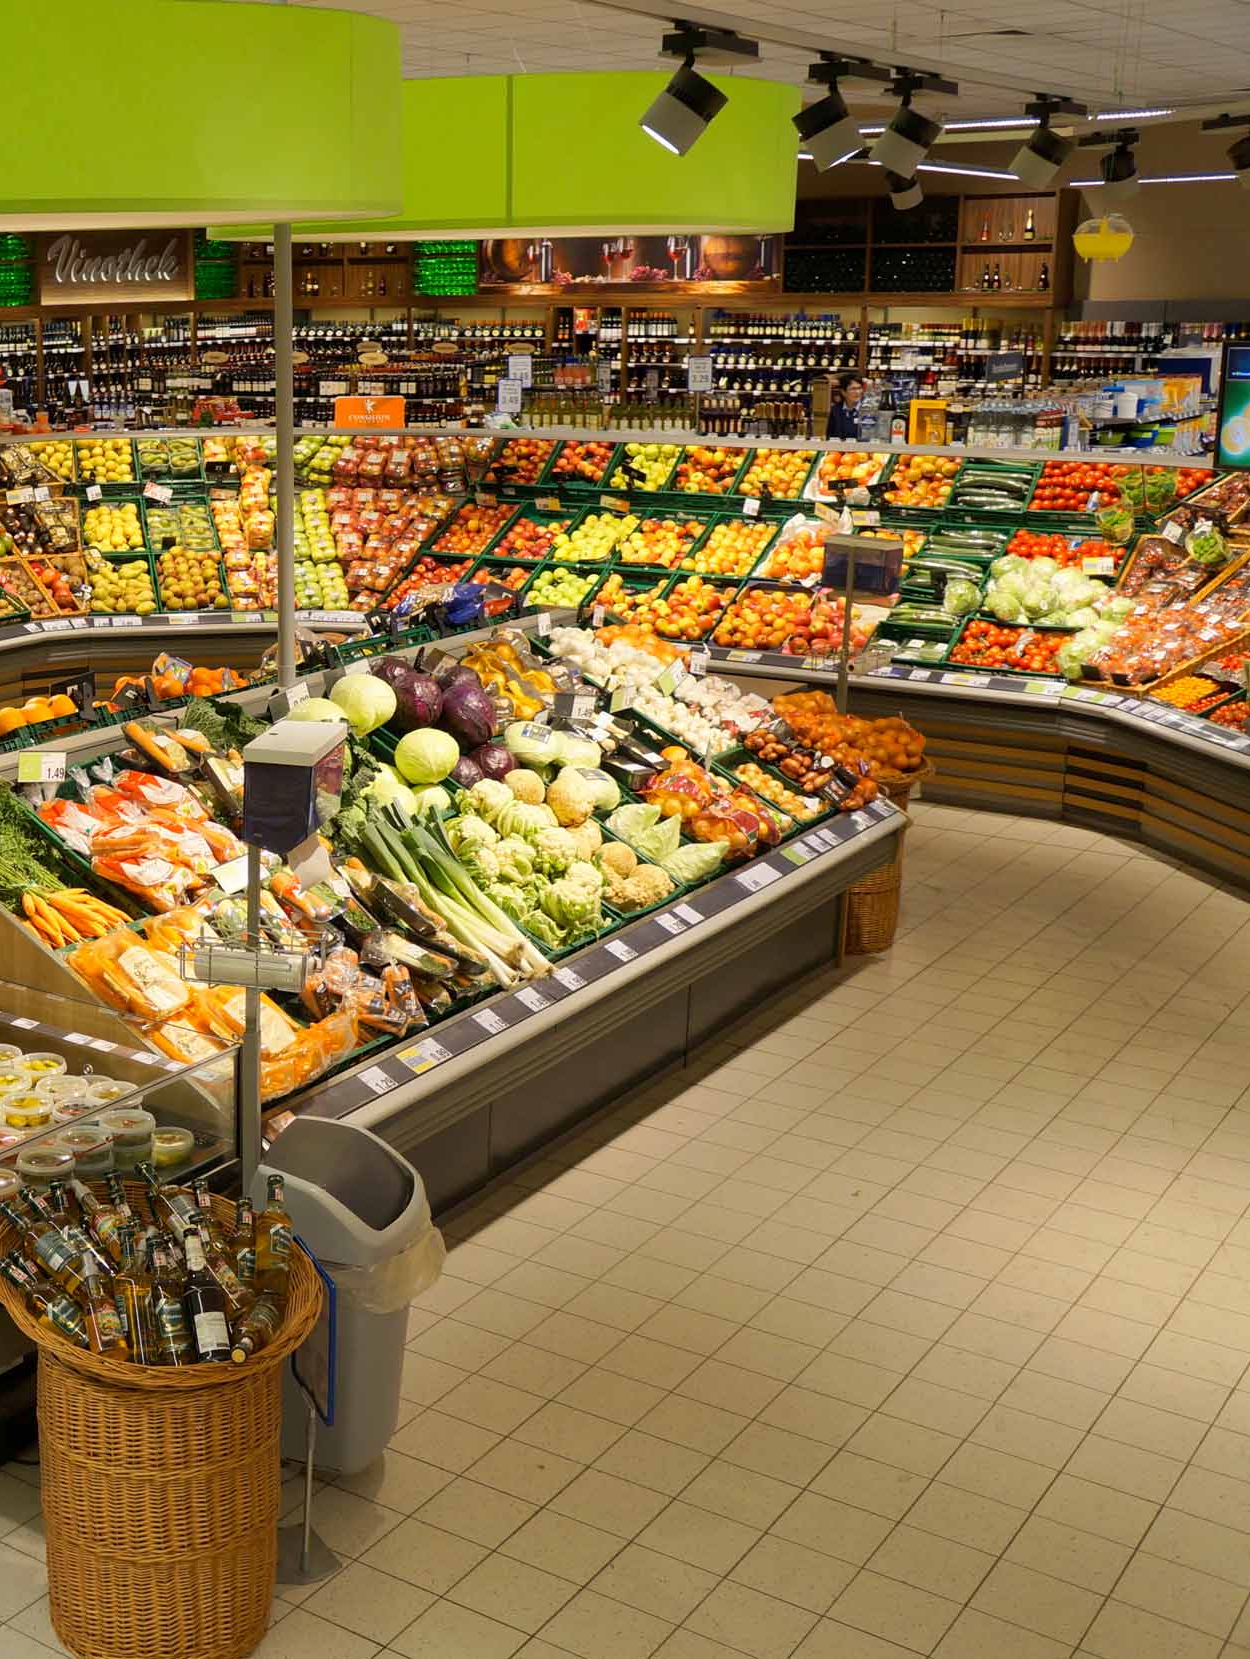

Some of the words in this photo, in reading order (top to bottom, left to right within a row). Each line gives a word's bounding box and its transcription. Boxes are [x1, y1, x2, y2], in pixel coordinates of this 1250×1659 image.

[47, 234, 180, 283] Vinothek
[47, 767, 65, 779] 1.49
[375, 1077, 398, 1092] 1.29
